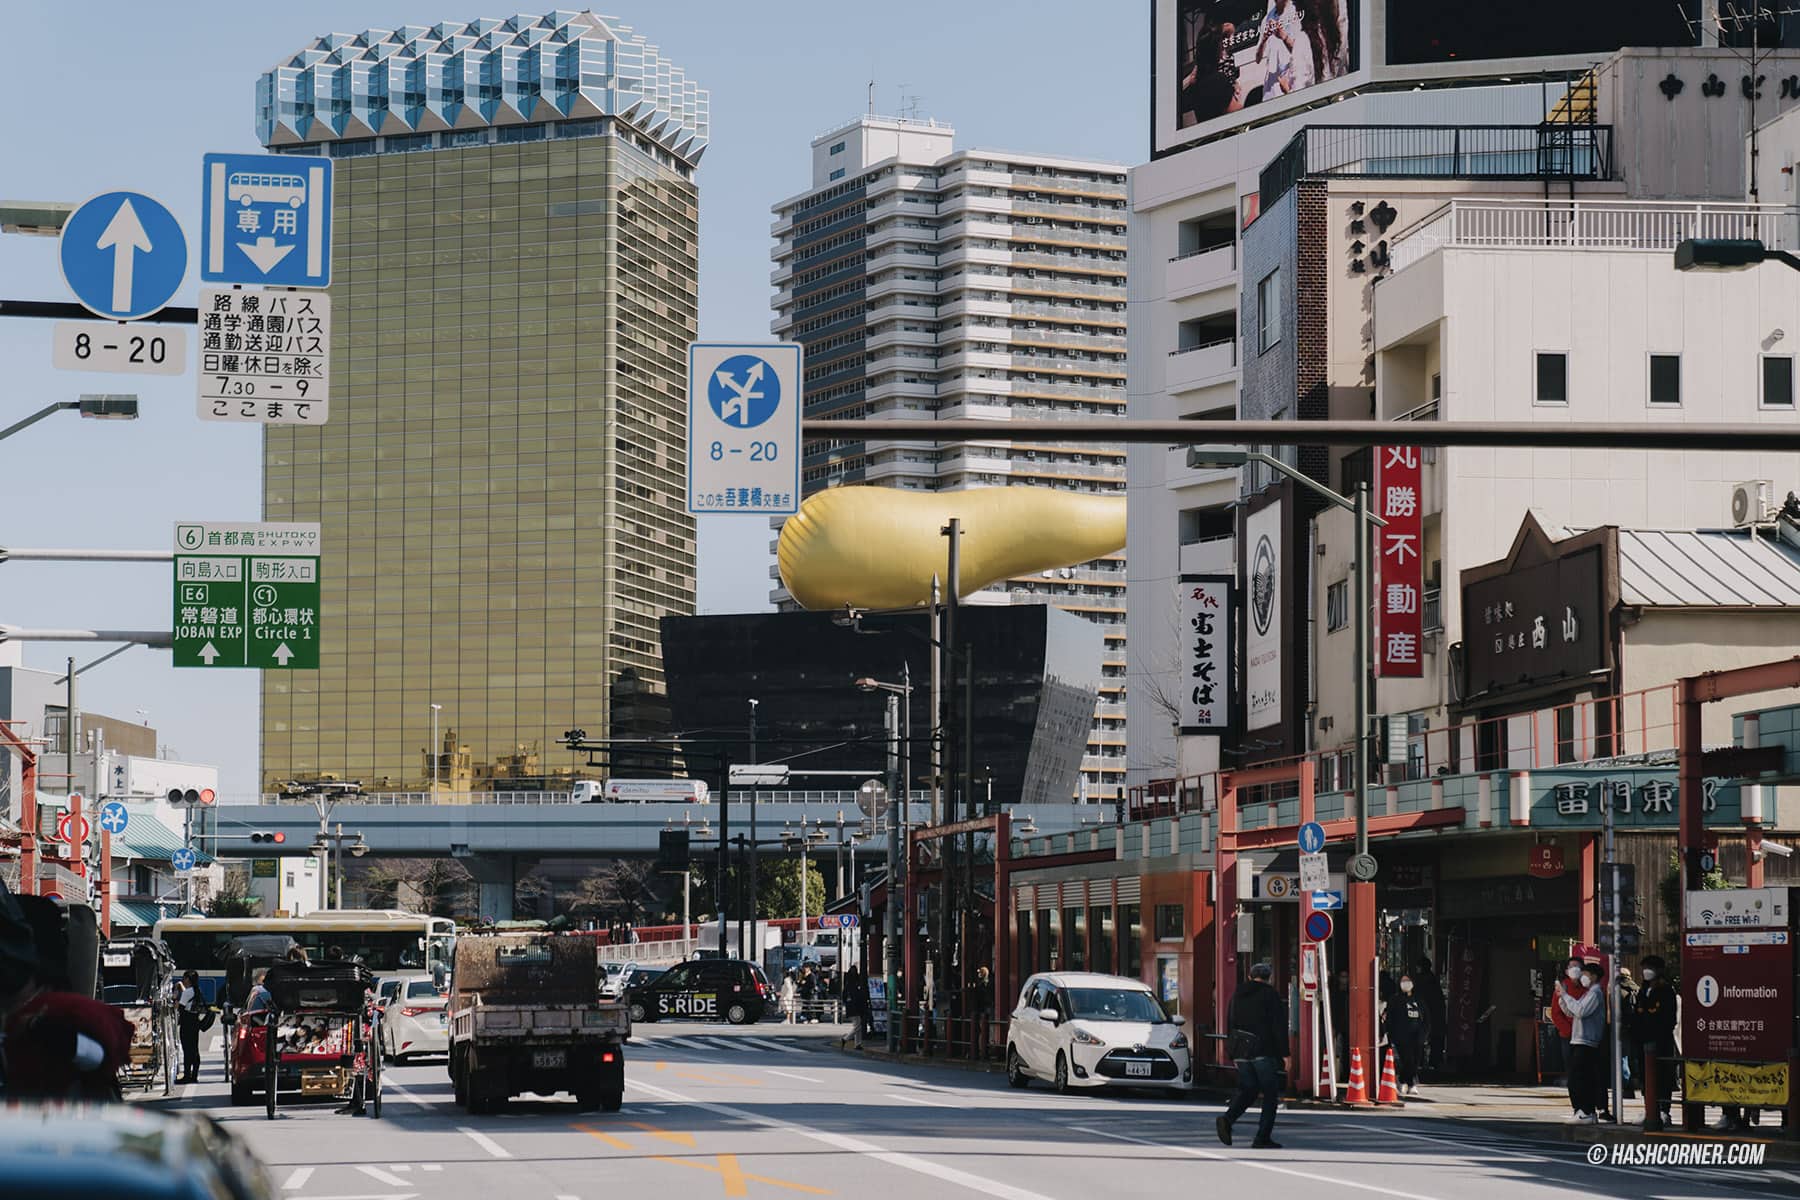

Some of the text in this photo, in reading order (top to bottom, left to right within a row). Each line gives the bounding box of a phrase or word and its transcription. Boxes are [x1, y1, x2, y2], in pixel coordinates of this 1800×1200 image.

[236, 209, 297, 235] 専用
[213, 295, 314, 314] 路線バス
[203, 332, 324, 353] 通勤送迎バス
[212, 401, 311, 419] ここまで
[696, 487, 791, 508] この先吾妻橋交差点
[185, 529, 196, 545] 6
[207, 531, 255, 546] 首都高
[1384, 446, 1417, 663] 丸勝不動産
[182, 561, 237, 579] 向島入口
[256, 561, 311, 579] 駒形入口
[185, 588, 204, 601] E6
[257, 589, 272, 602] C1
[181, 607, 238, 624] 常磐道
[252, 608, 314, 625] 都心環状
[175, 626, 242, 640] JOBAN EXP
[255, 627, 311, 639] Circle 1
[1531, 606, 1577, 649] 西山
[1198, 709, 1211, 718] 24
[1723, 986, 1777, 999] Information
